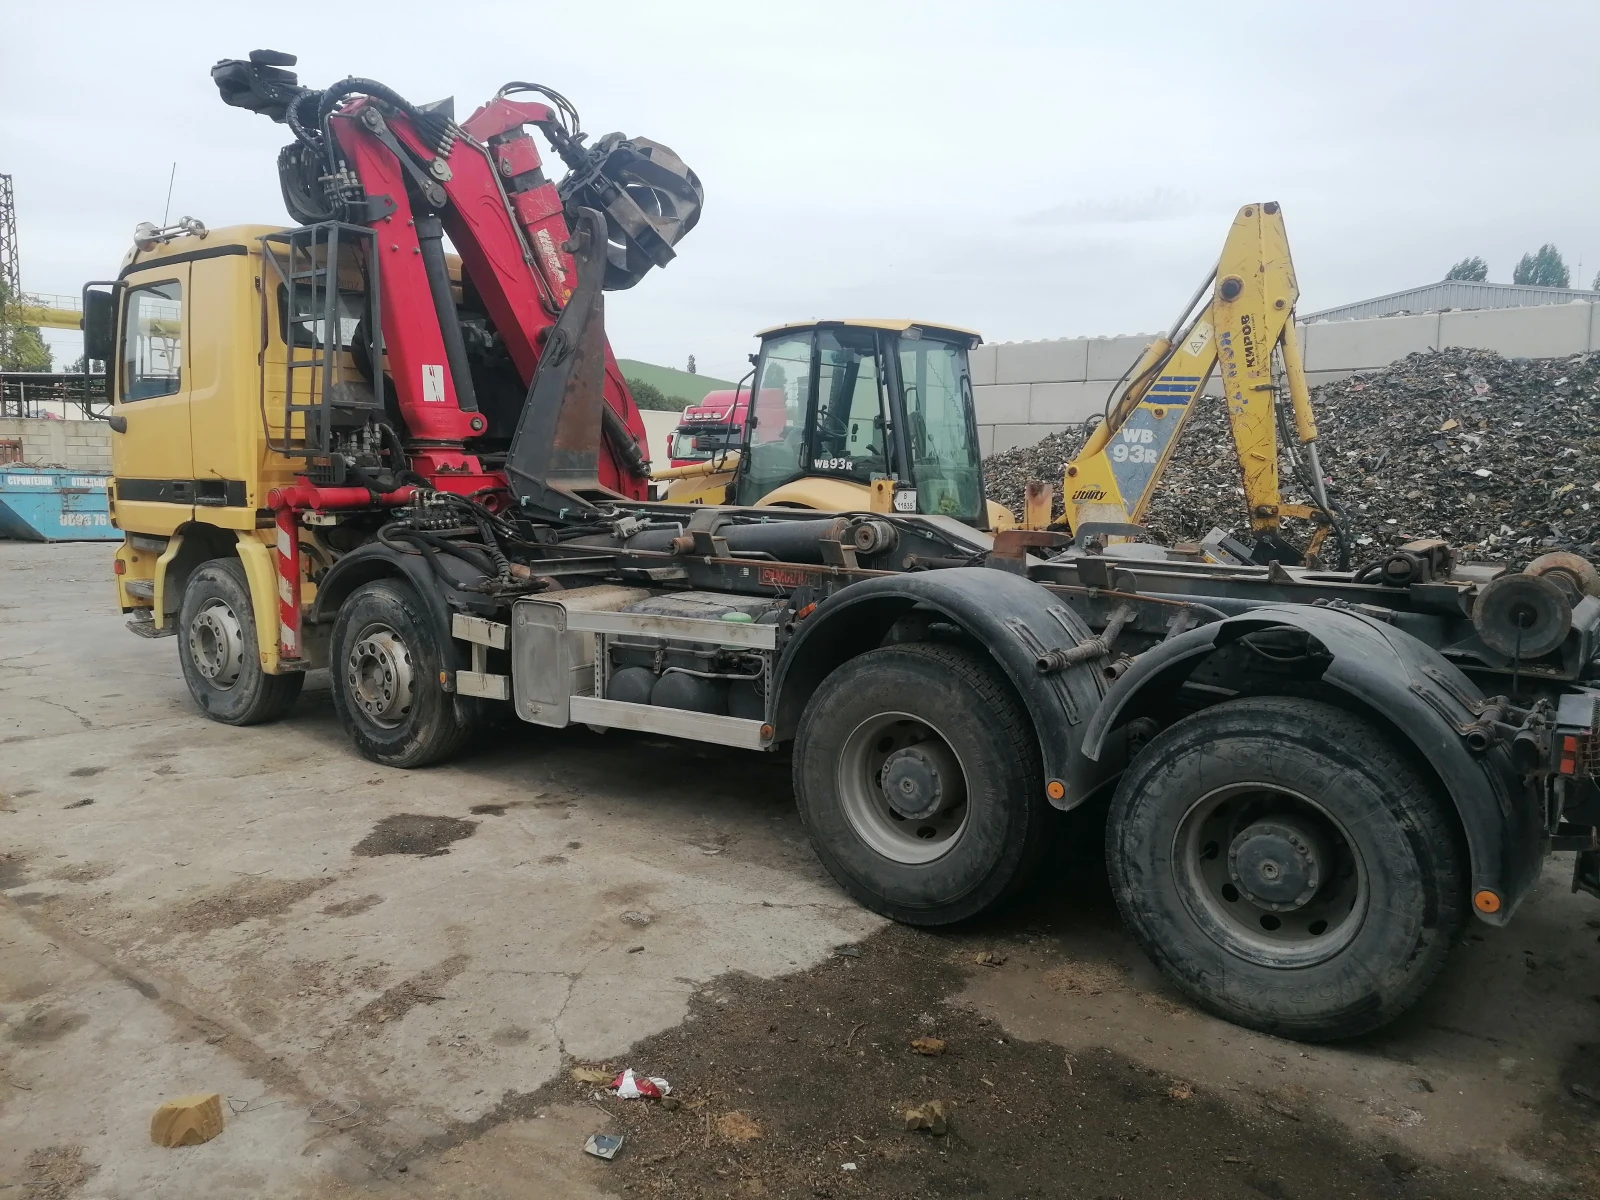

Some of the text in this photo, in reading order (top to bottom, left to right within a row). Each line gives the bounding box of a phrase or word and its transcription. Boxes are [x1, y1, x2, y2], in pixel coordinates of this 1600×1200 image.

[1241, 314, 1256, 368] КИРОВ
[1122, 428, 1154, 443] WB
[1112, 443, 1158, 464] 93R
[813, 457, 853, 471] WB93R
[1071, 490, 1107, 501] Utility
